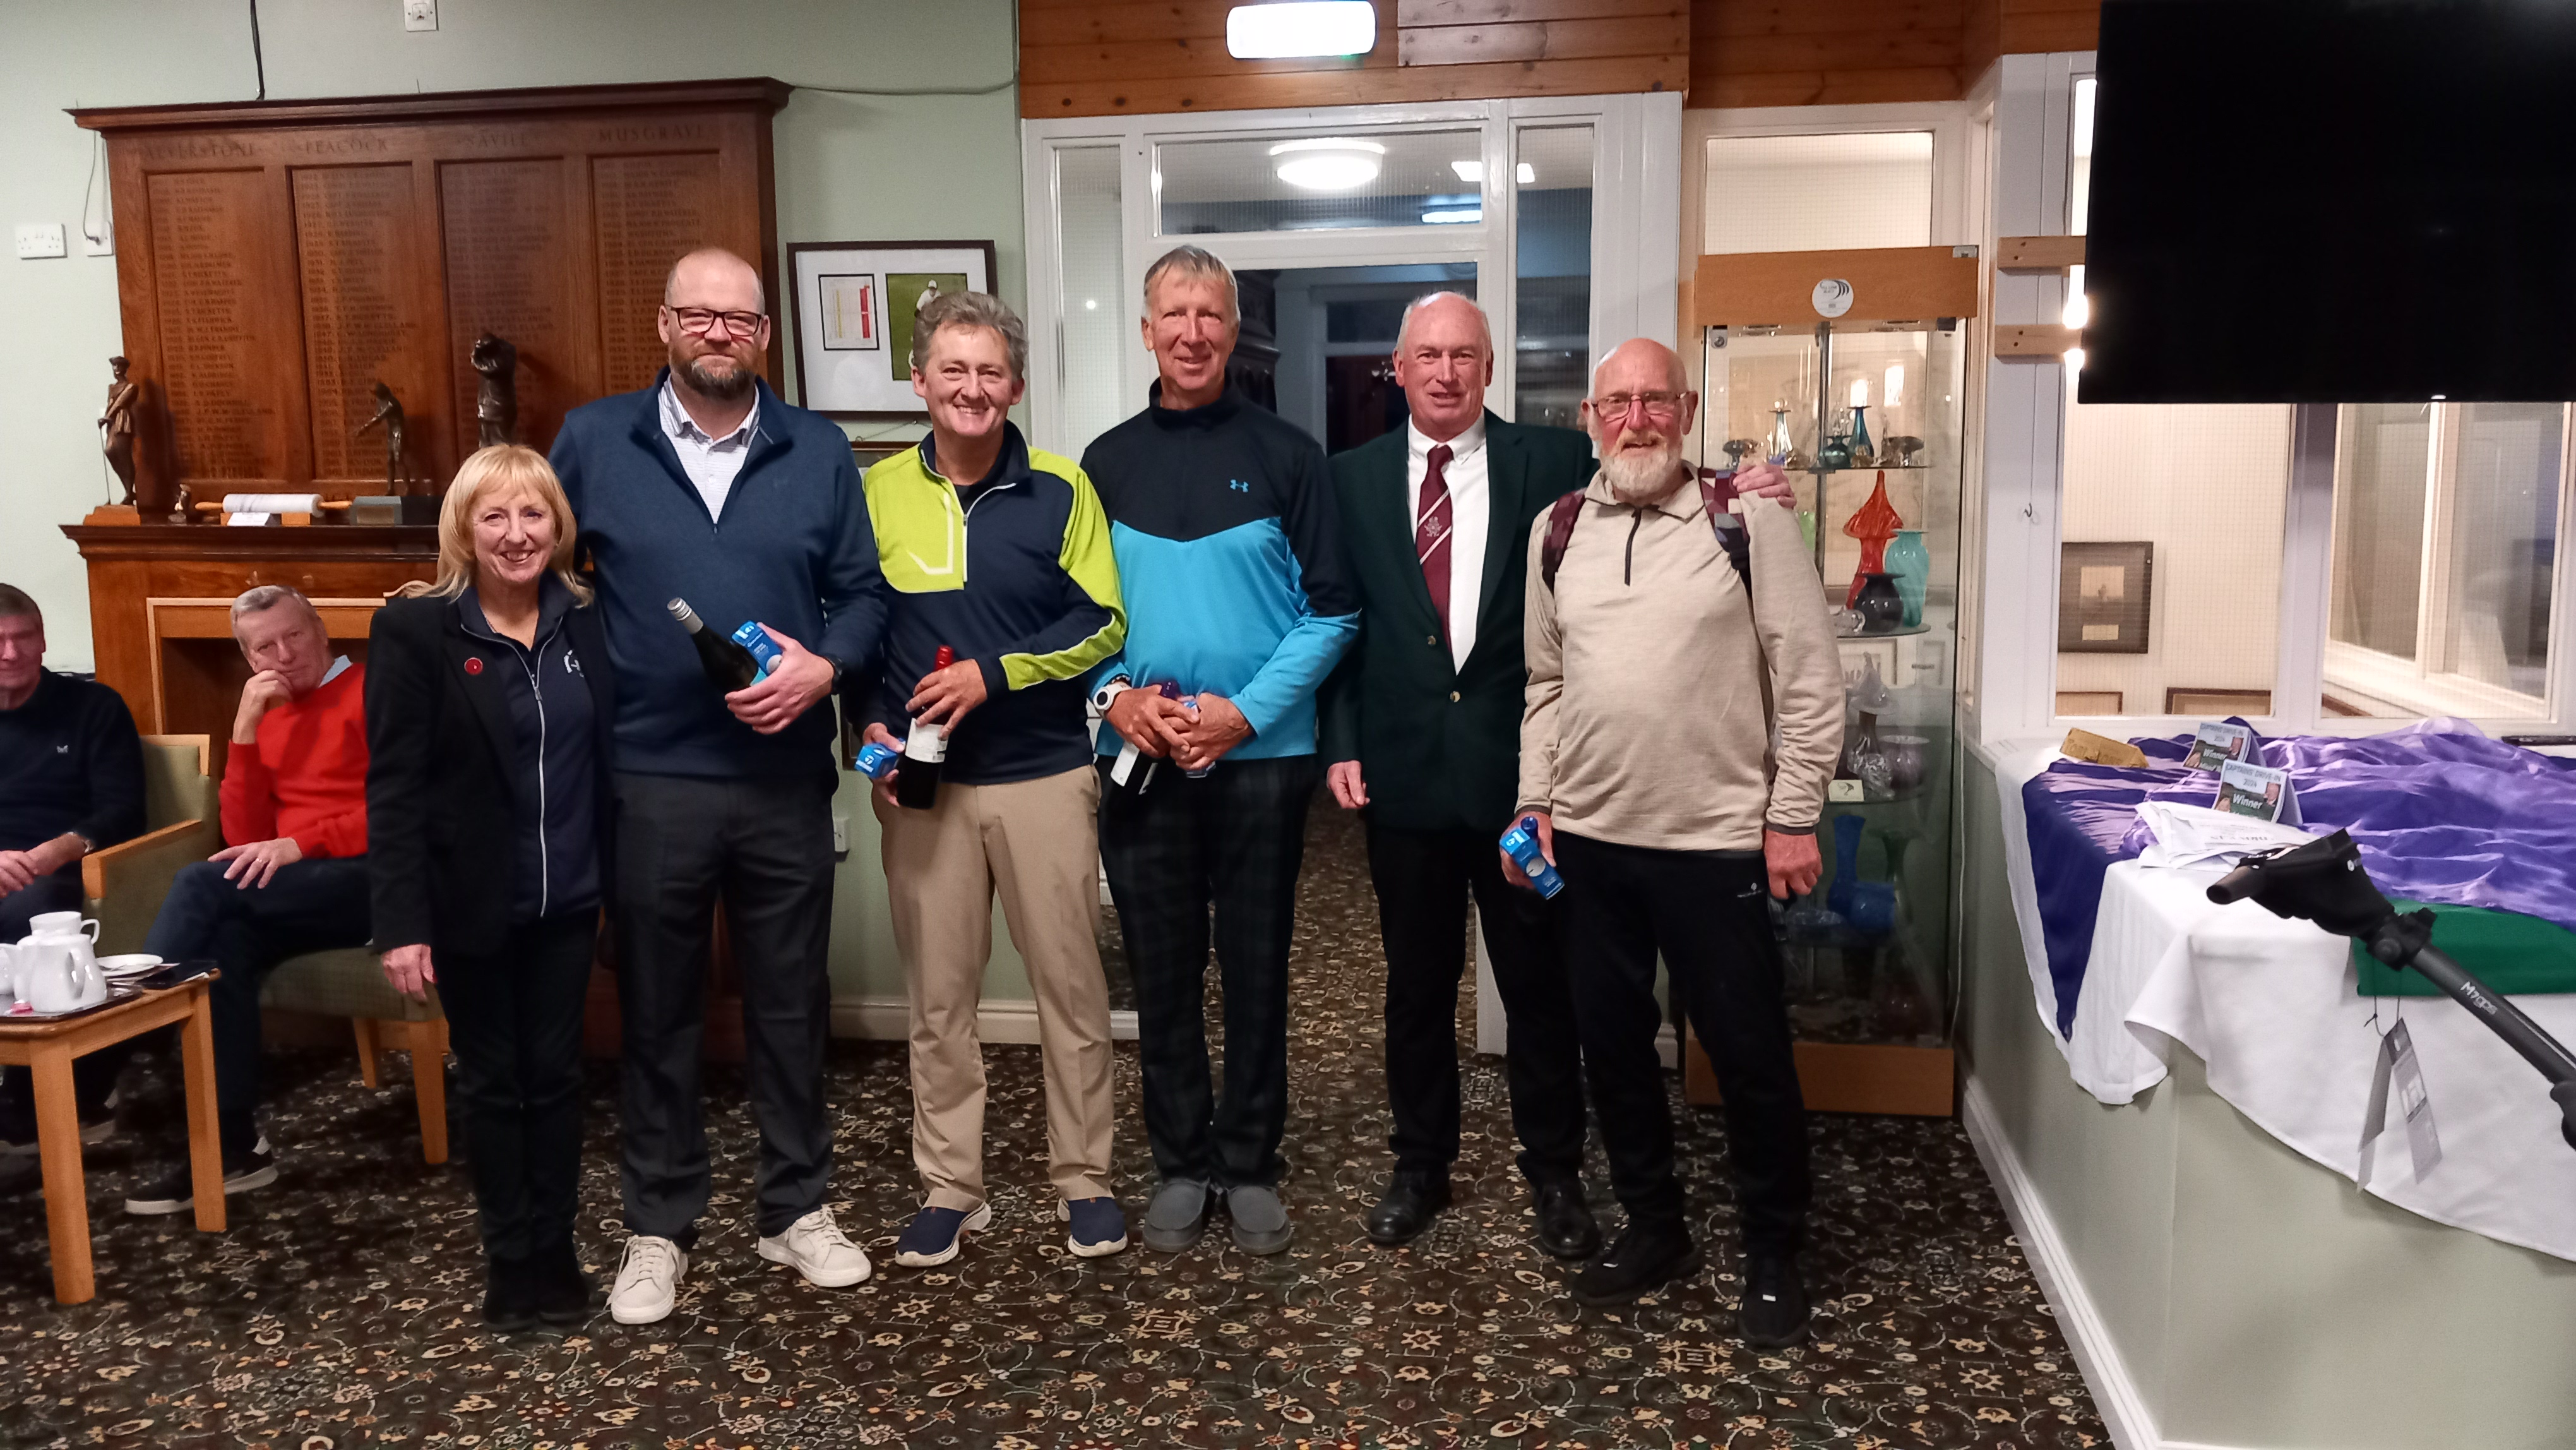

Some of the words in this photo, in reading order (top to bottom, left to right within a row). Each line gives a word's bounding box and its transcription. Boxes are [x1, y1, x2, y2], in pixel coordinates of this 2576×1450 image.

[306, 138, 388, 155] PEACOCK
[2202, 748, 2227, 760] Winner
[2243, 778, 2257, 788] 2024
[2233, 793, 2263, 810] Winner
